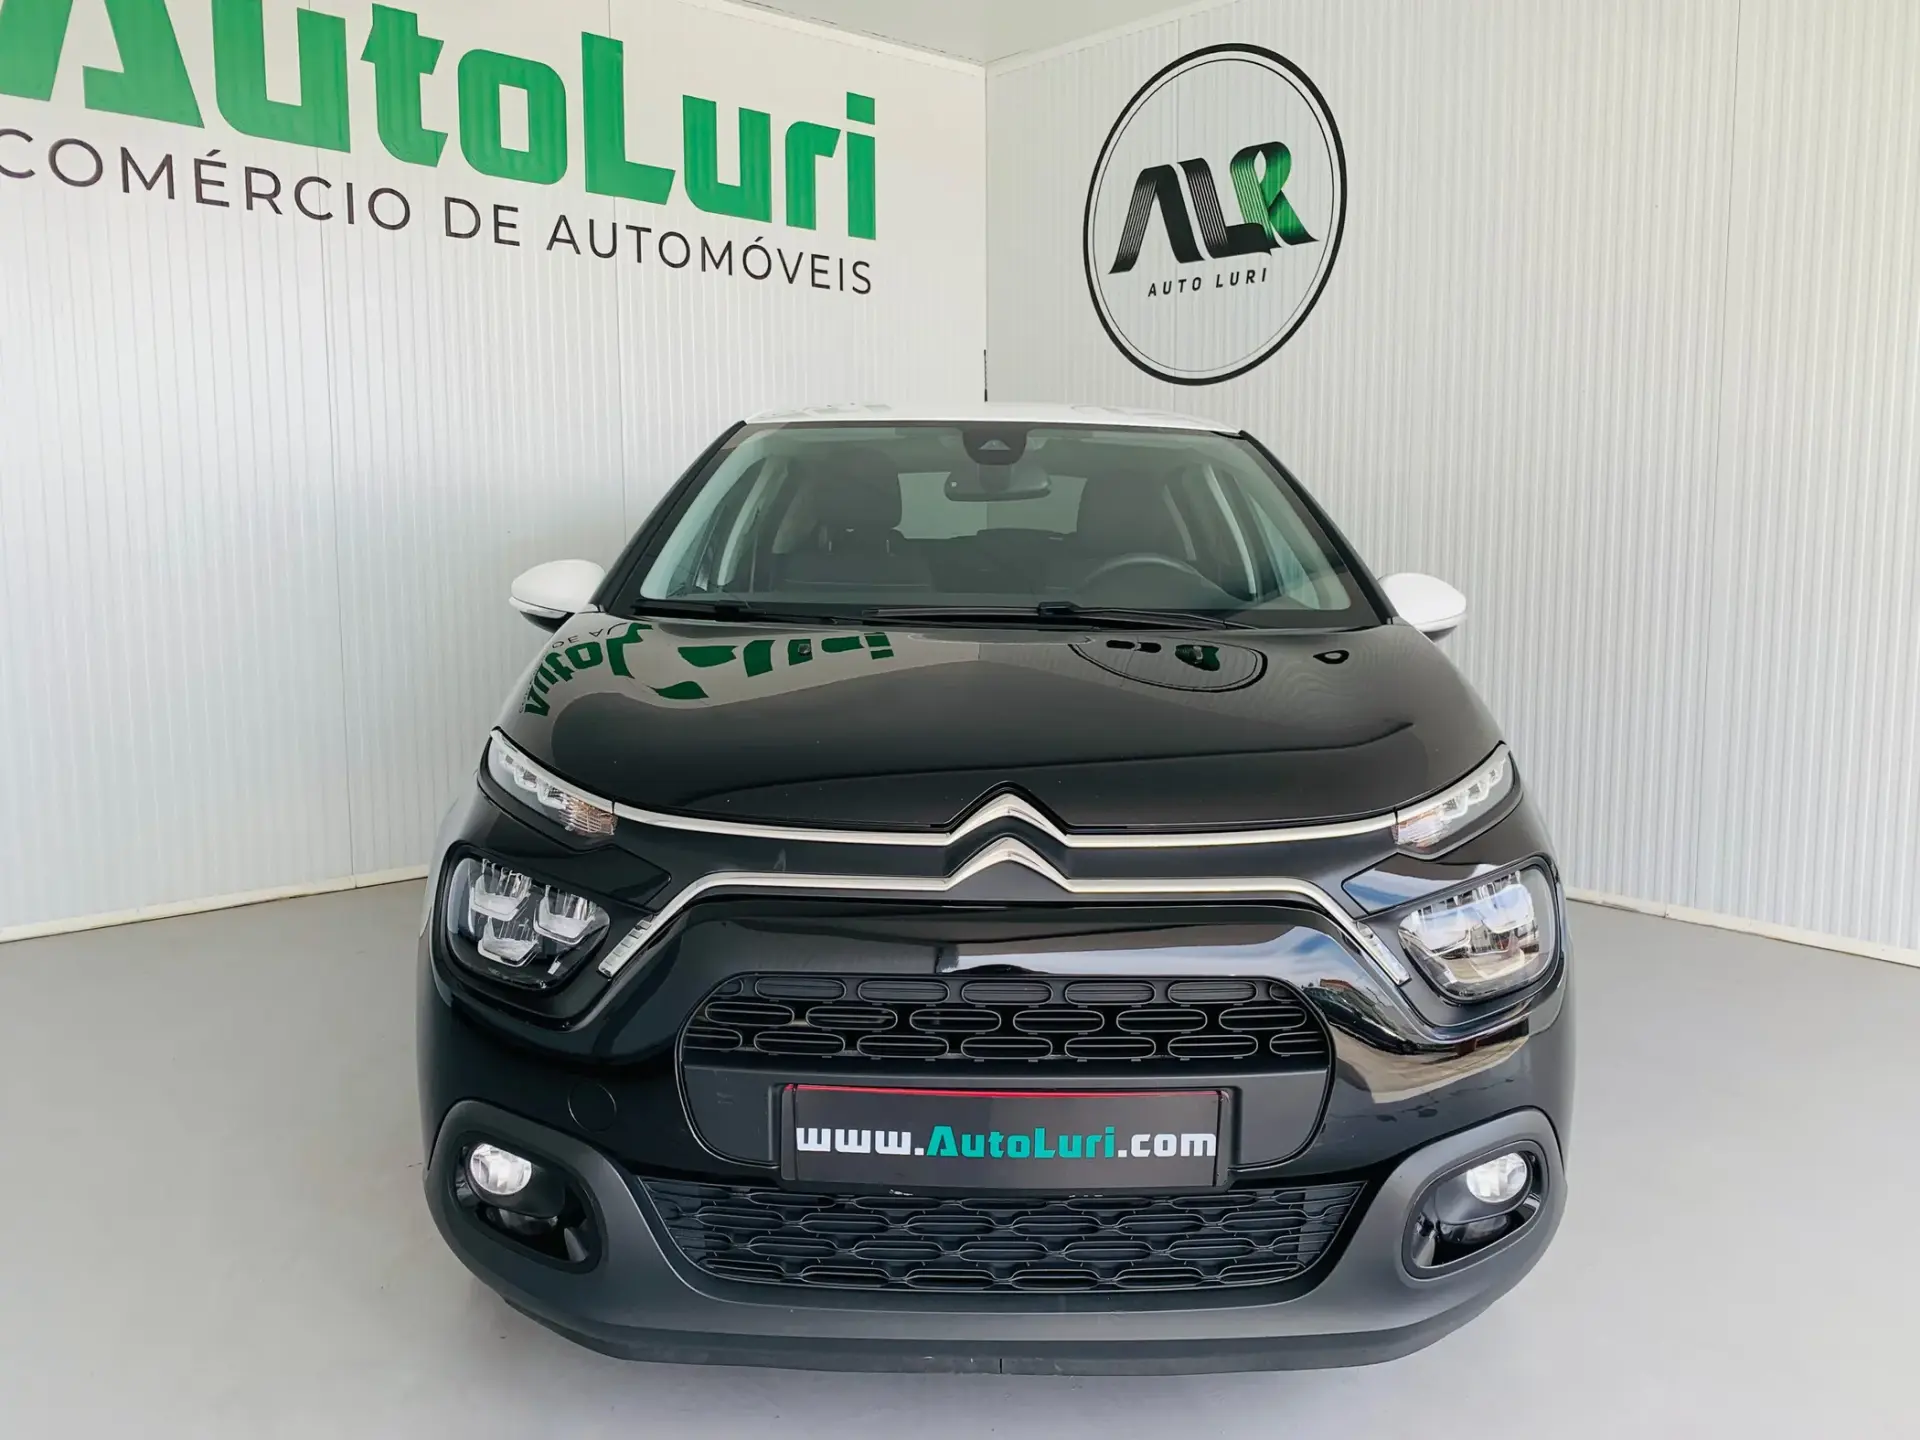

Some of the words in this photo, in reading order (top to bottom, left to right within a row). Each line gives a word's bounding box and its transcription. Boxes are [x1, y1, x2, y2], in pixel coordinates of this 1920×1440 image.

[0, 0, 877, 240] AutoLuri
[0, 127, 411, 231] COMÉRCIO
[444, 196, 520, 247] DE
[546, 214, 872, 295] AUTOMÓVEIS
[1147, 276, 1202, 297] AUTO
[1215, 267, 1267, 289] LURI
[796, 1124, 1217, 1160] www.AutoLuri.com
